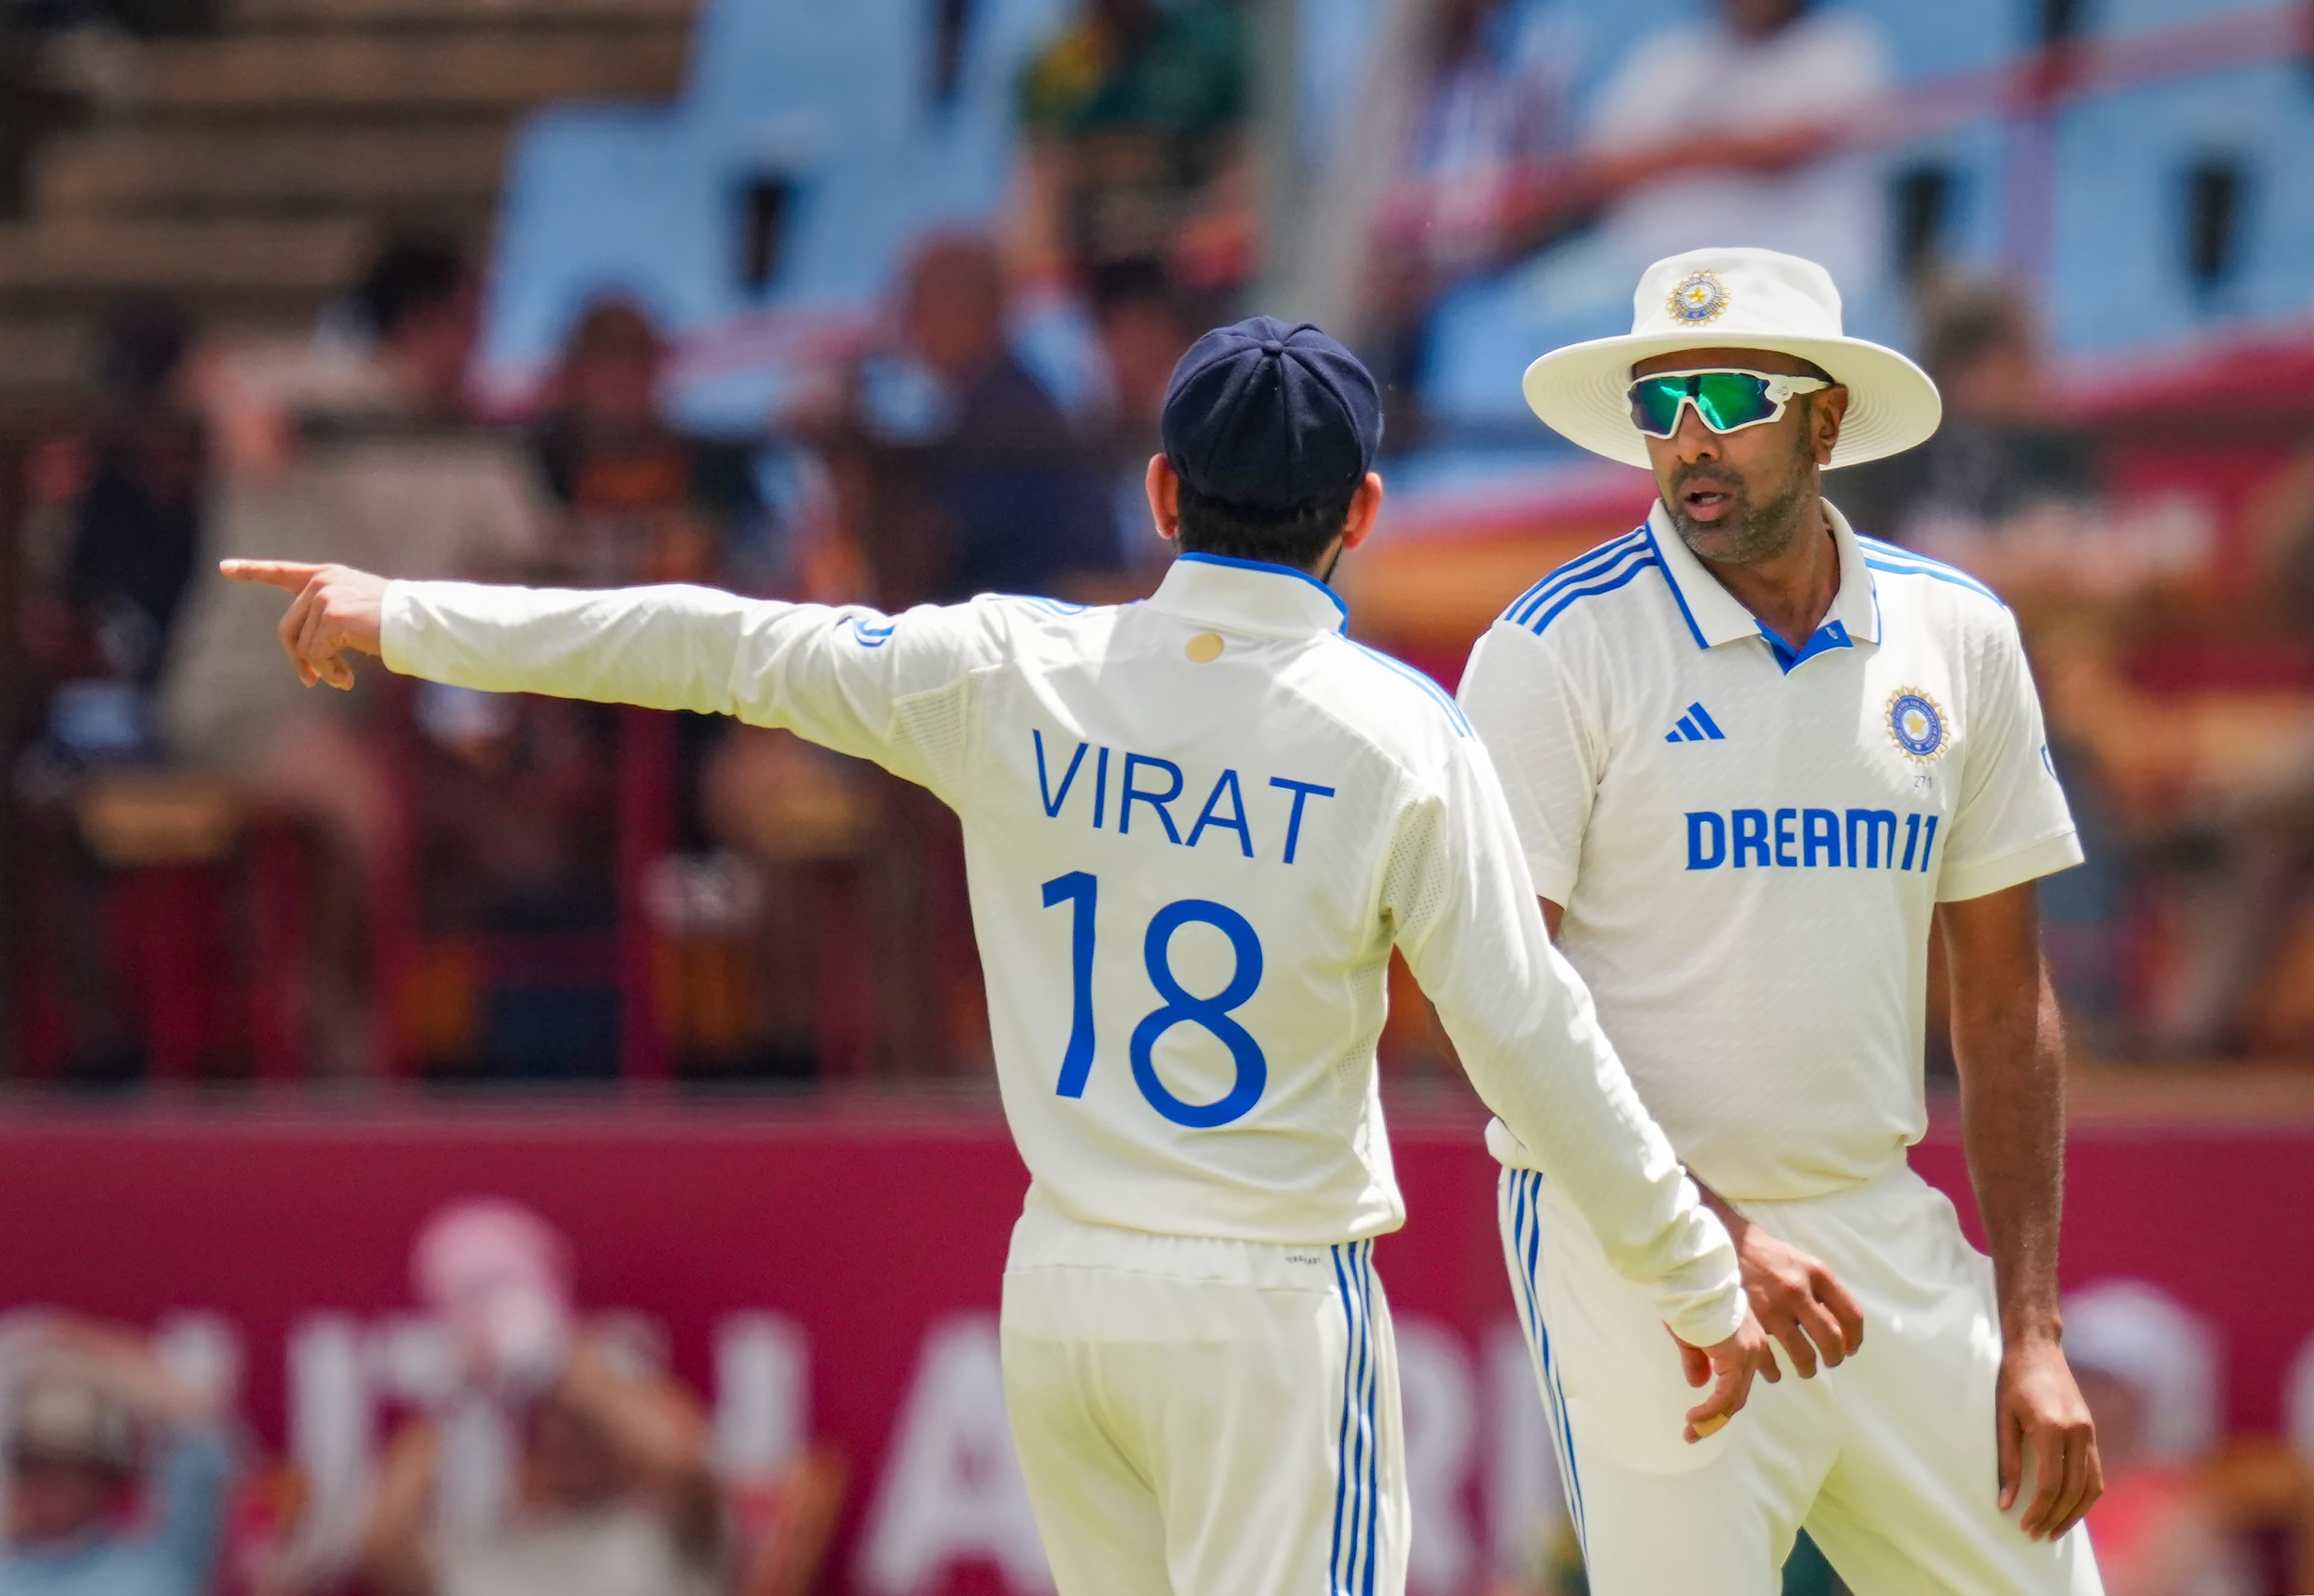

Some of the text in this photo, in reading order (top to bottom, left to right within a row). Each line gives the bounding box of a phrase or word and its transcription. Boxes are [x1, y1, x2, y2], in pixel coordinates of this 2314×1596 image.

[1032, 729, 1335, 864] VIRAT
[1913, 775, 1933, 789] 271
[1684, 808, 1939, 872] DREAM11
[1041, 871, 1267, 1128] 18
